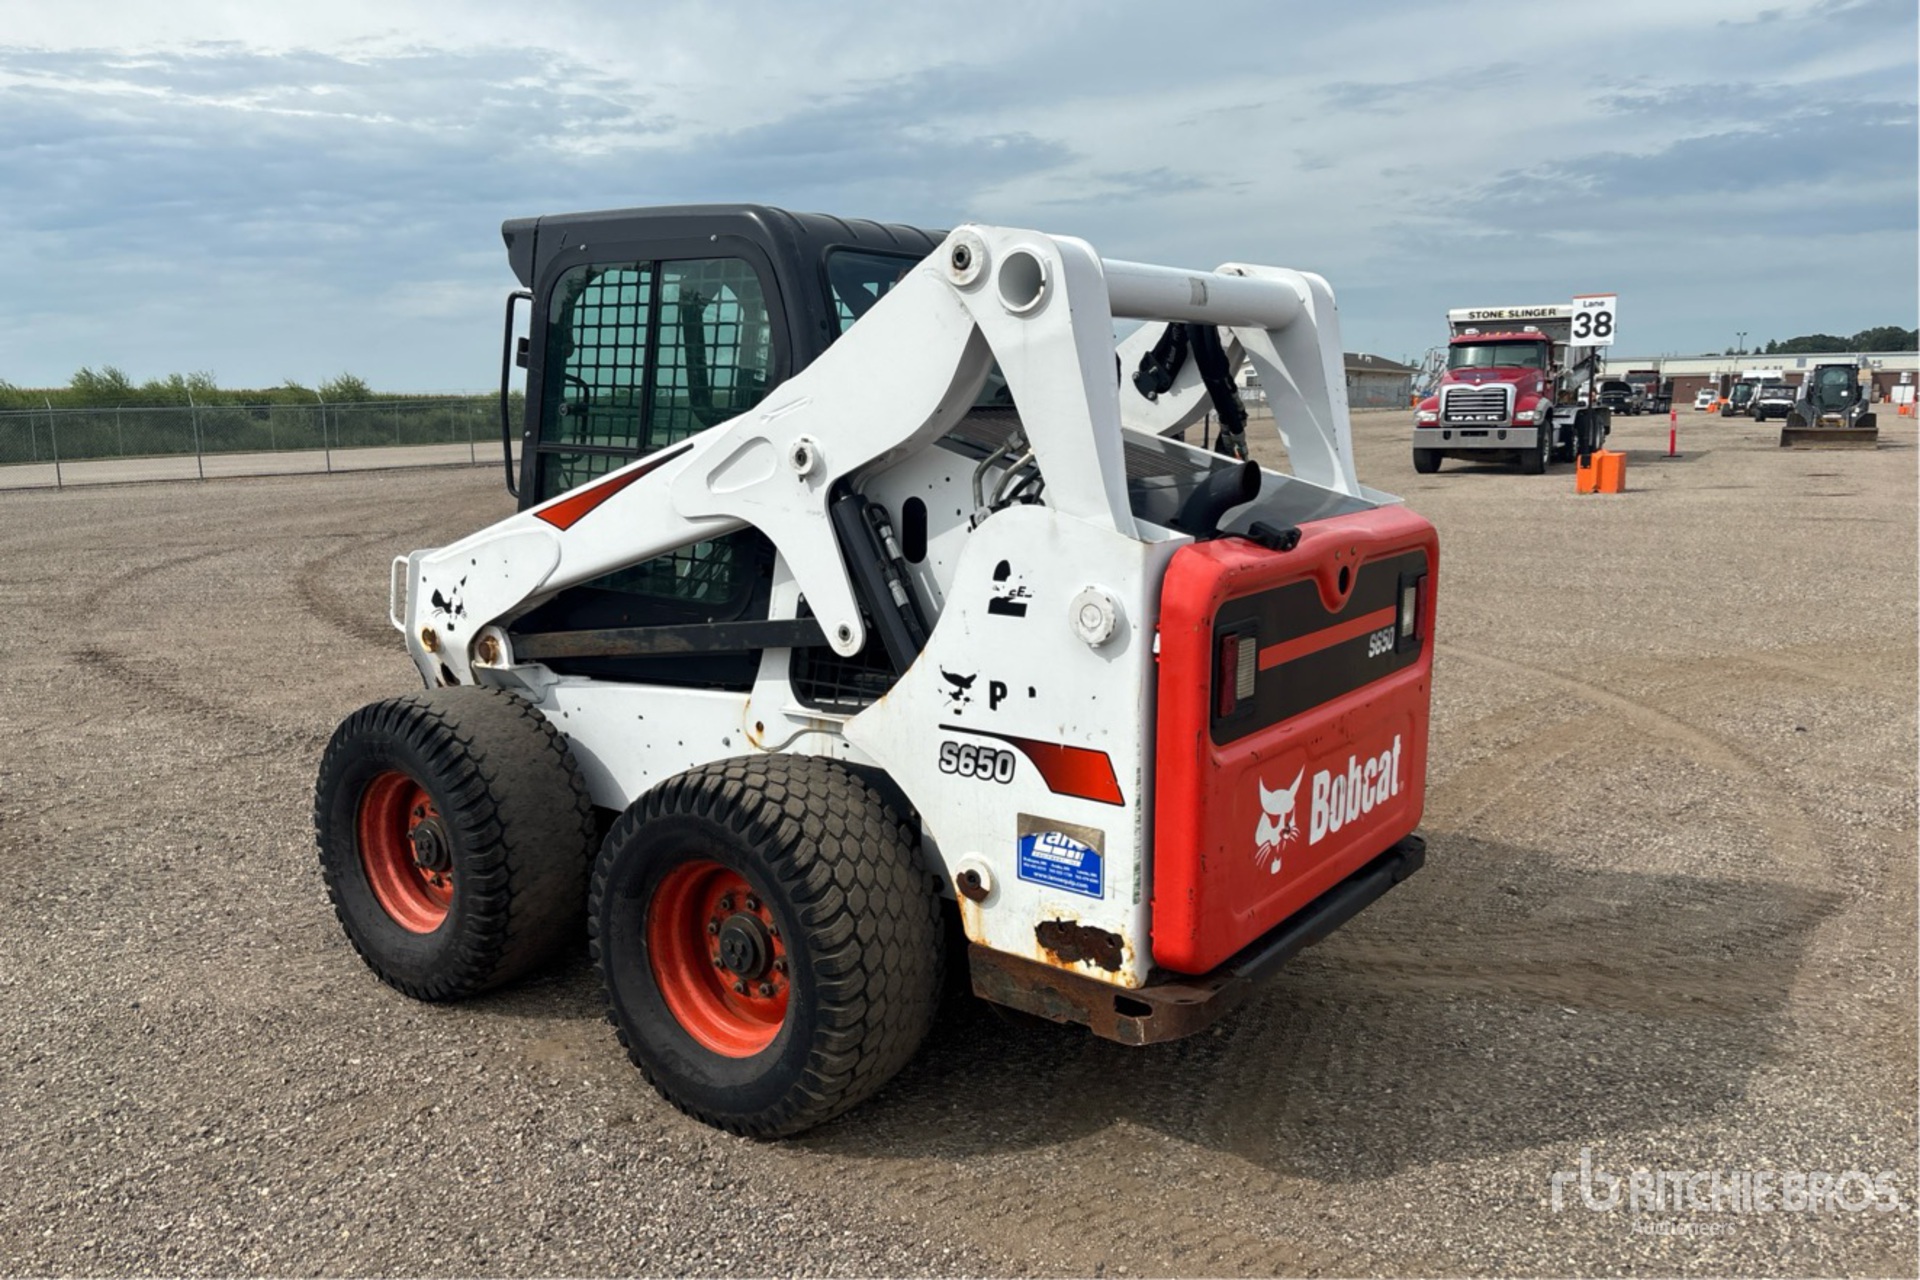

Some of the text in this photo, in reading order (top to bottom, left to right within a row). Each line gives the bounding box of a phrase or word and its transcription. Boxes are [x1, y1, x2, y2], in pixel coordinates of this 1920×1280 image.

[1468, 307, 1557, 320] STONE SLINGER
[1582, 300, 1606, 309] Lane
[1573, 311, 1613, 339] 38
[1450, 414, 1500, 422] MACK
[1368, 626, 1395, 658] S650
[938, 740, 1017, 785] S650
[1309, 733, 1401, 846] Bobcat
